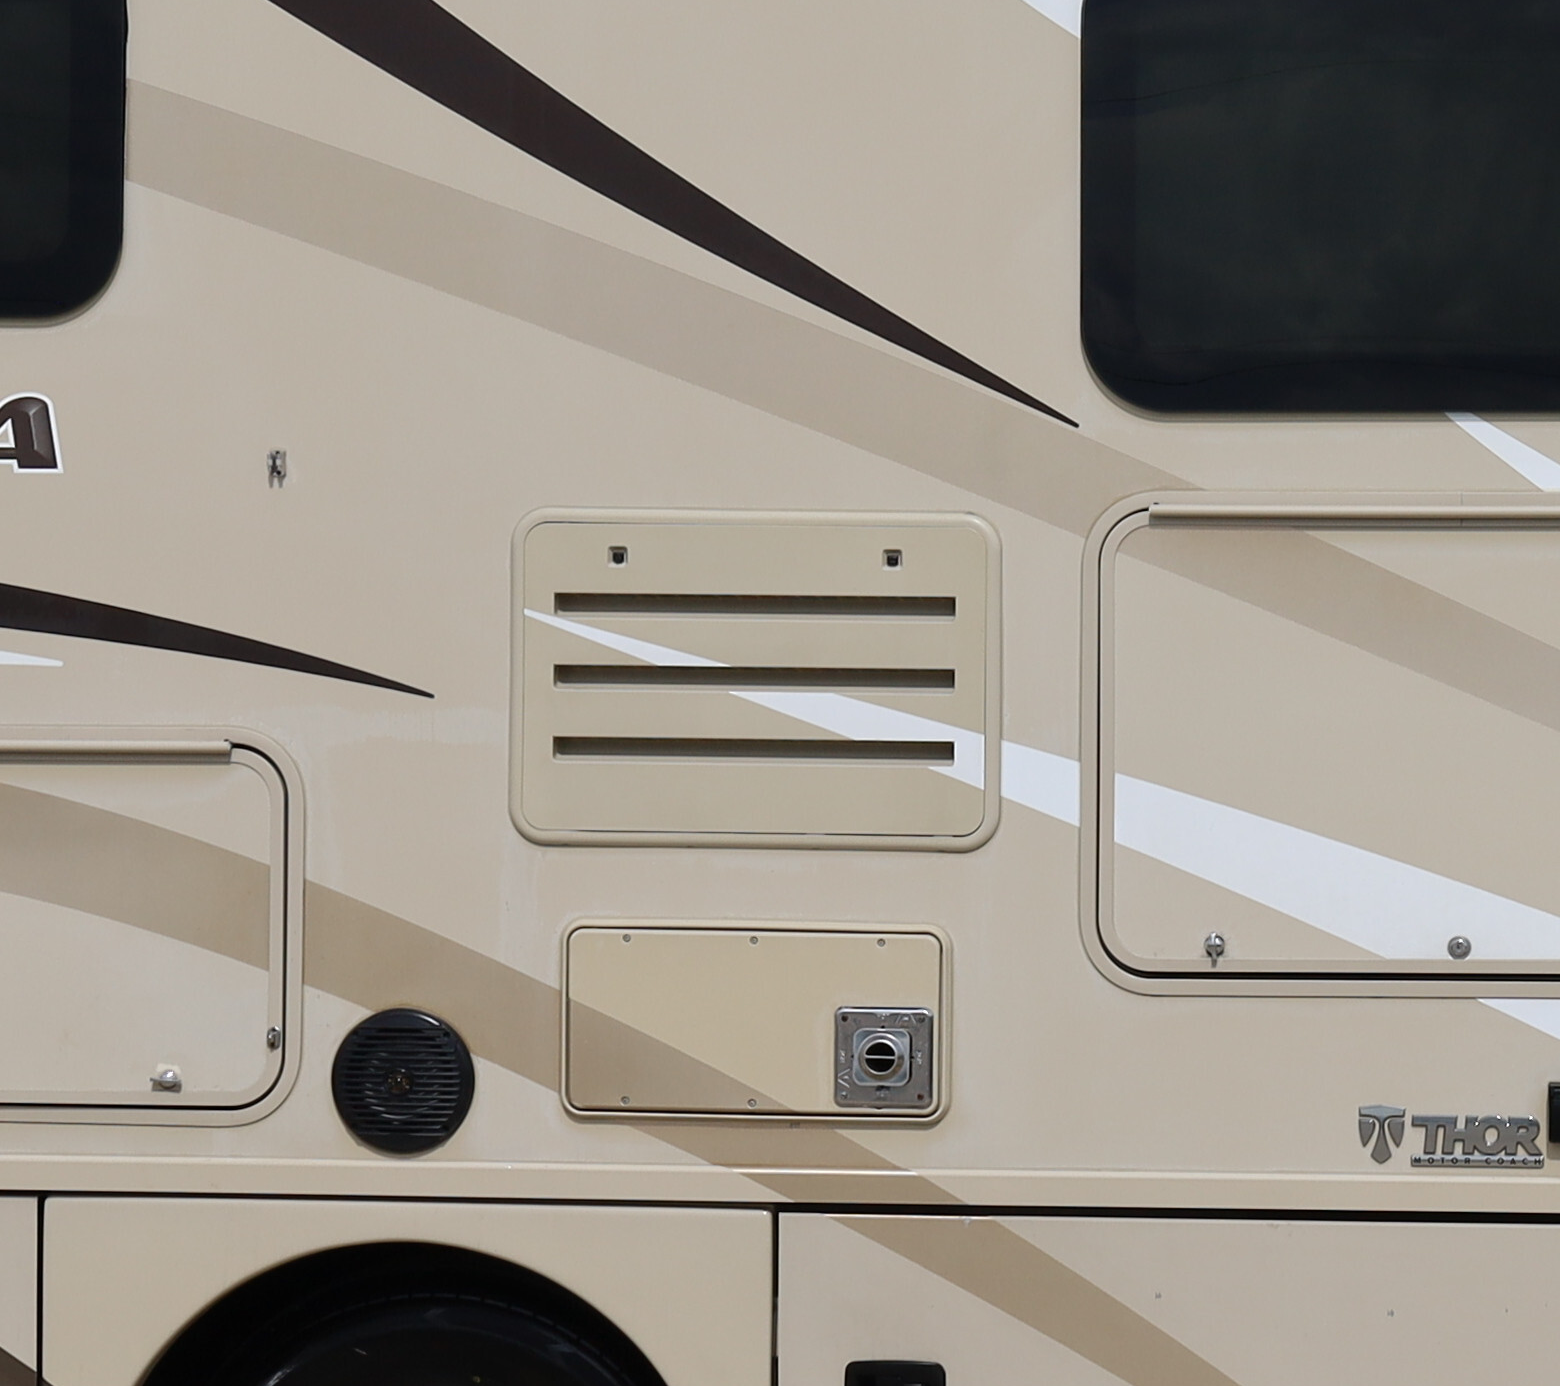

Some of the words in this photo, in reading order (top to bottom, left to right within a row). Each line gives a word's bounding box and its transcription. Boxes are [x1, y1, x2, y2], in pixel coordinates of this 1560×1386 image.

[1411, 1115, 1544, 1156] THOR
[1413, 1157, 1471, 1166] MOTOR
[1484, 1157, 1543, 1166] COACH
